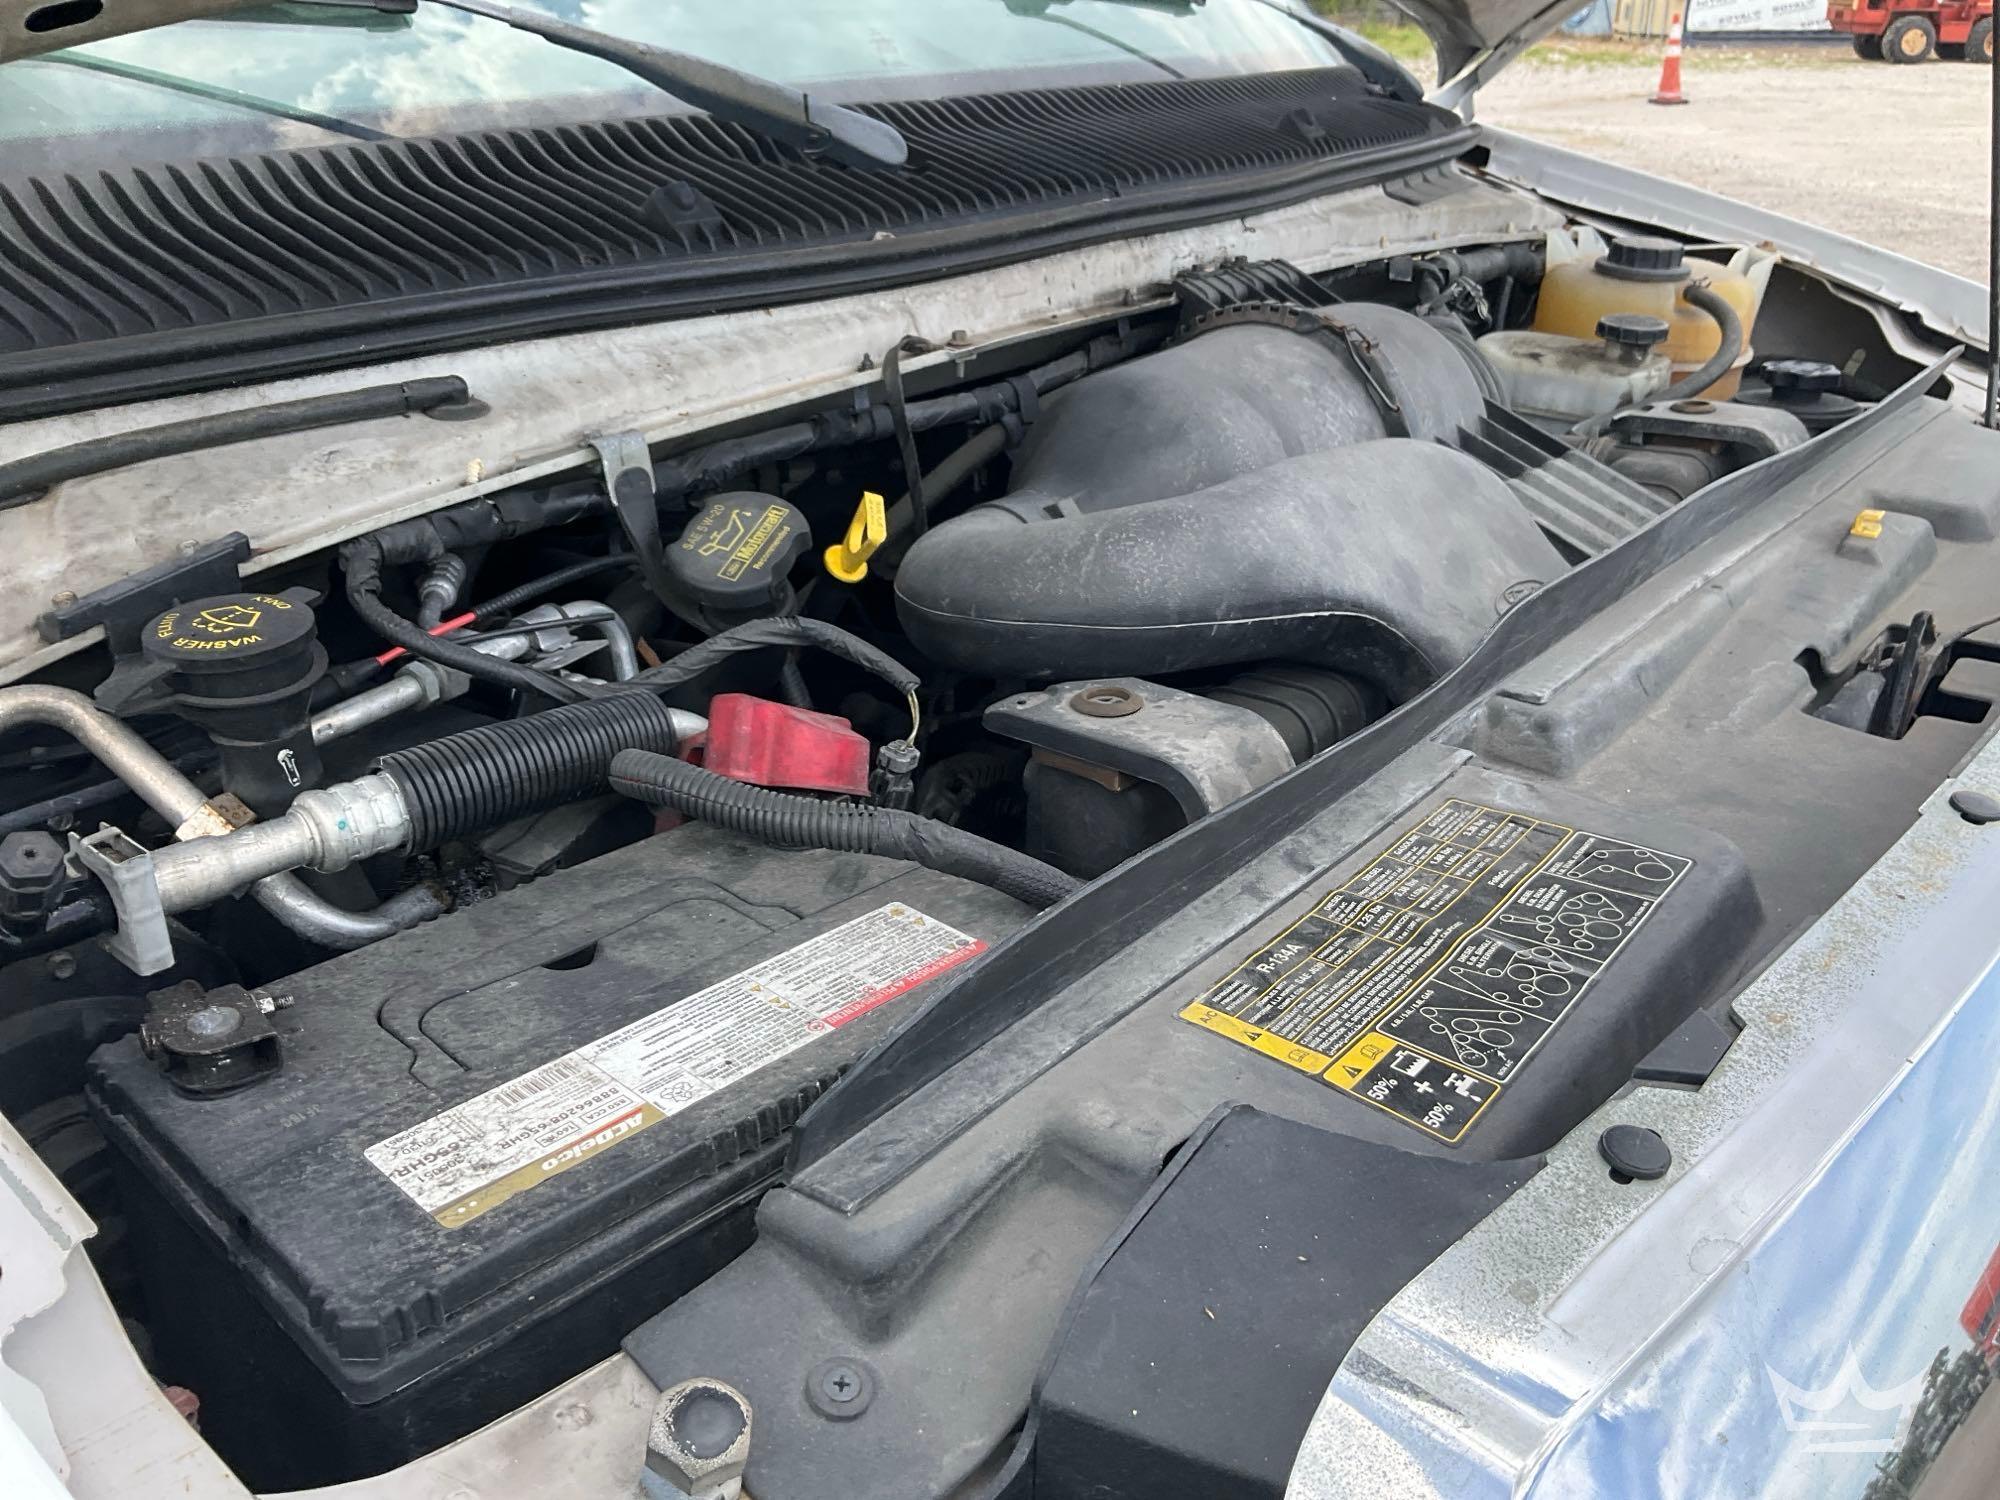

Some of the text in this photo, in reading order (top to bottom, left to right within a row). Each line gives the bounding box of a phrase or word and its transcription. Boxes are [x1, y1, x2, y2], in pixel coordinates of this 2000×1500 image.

[682, 504, 725, 550] SAE 5W-20
[737, 507, 786, 559] Motorcraft
[753, 525, 790, 570] Recommended
[157, 596, 292, 649] WASHER FLUID ONLY
[1391, 834, 1422, 854] GASOLINE
[1515, 888, 1535, 903] DIESEL
[1532, 883, 1562, 908] ALTERNATOR
[1354, 913, 1376, 927] 2.25
[1254, 940, 1304, 974] R-134A
[1454, 944, 1478, 962] DIESEL
[1472, 939, 1494, 955] SINGLE
[1293, 972, 1312, 984] SAE
[1198, 1009, 1218, 1023] A/C
[1365, 1075, 1400, 1101] 50%
[547, 1086, 620, 1124] 88866208
[585, 1097, 627, 1120] 850 CCA
[1419, 1099, 1455, 1128] 50%
[497, 1122, 549, 1150] 65GHR
[540, 1111, 645, 1172] ACDelco
[554, 1124, 575, 1136] 160
[393, 1140, 463, 1178] 65GHR
